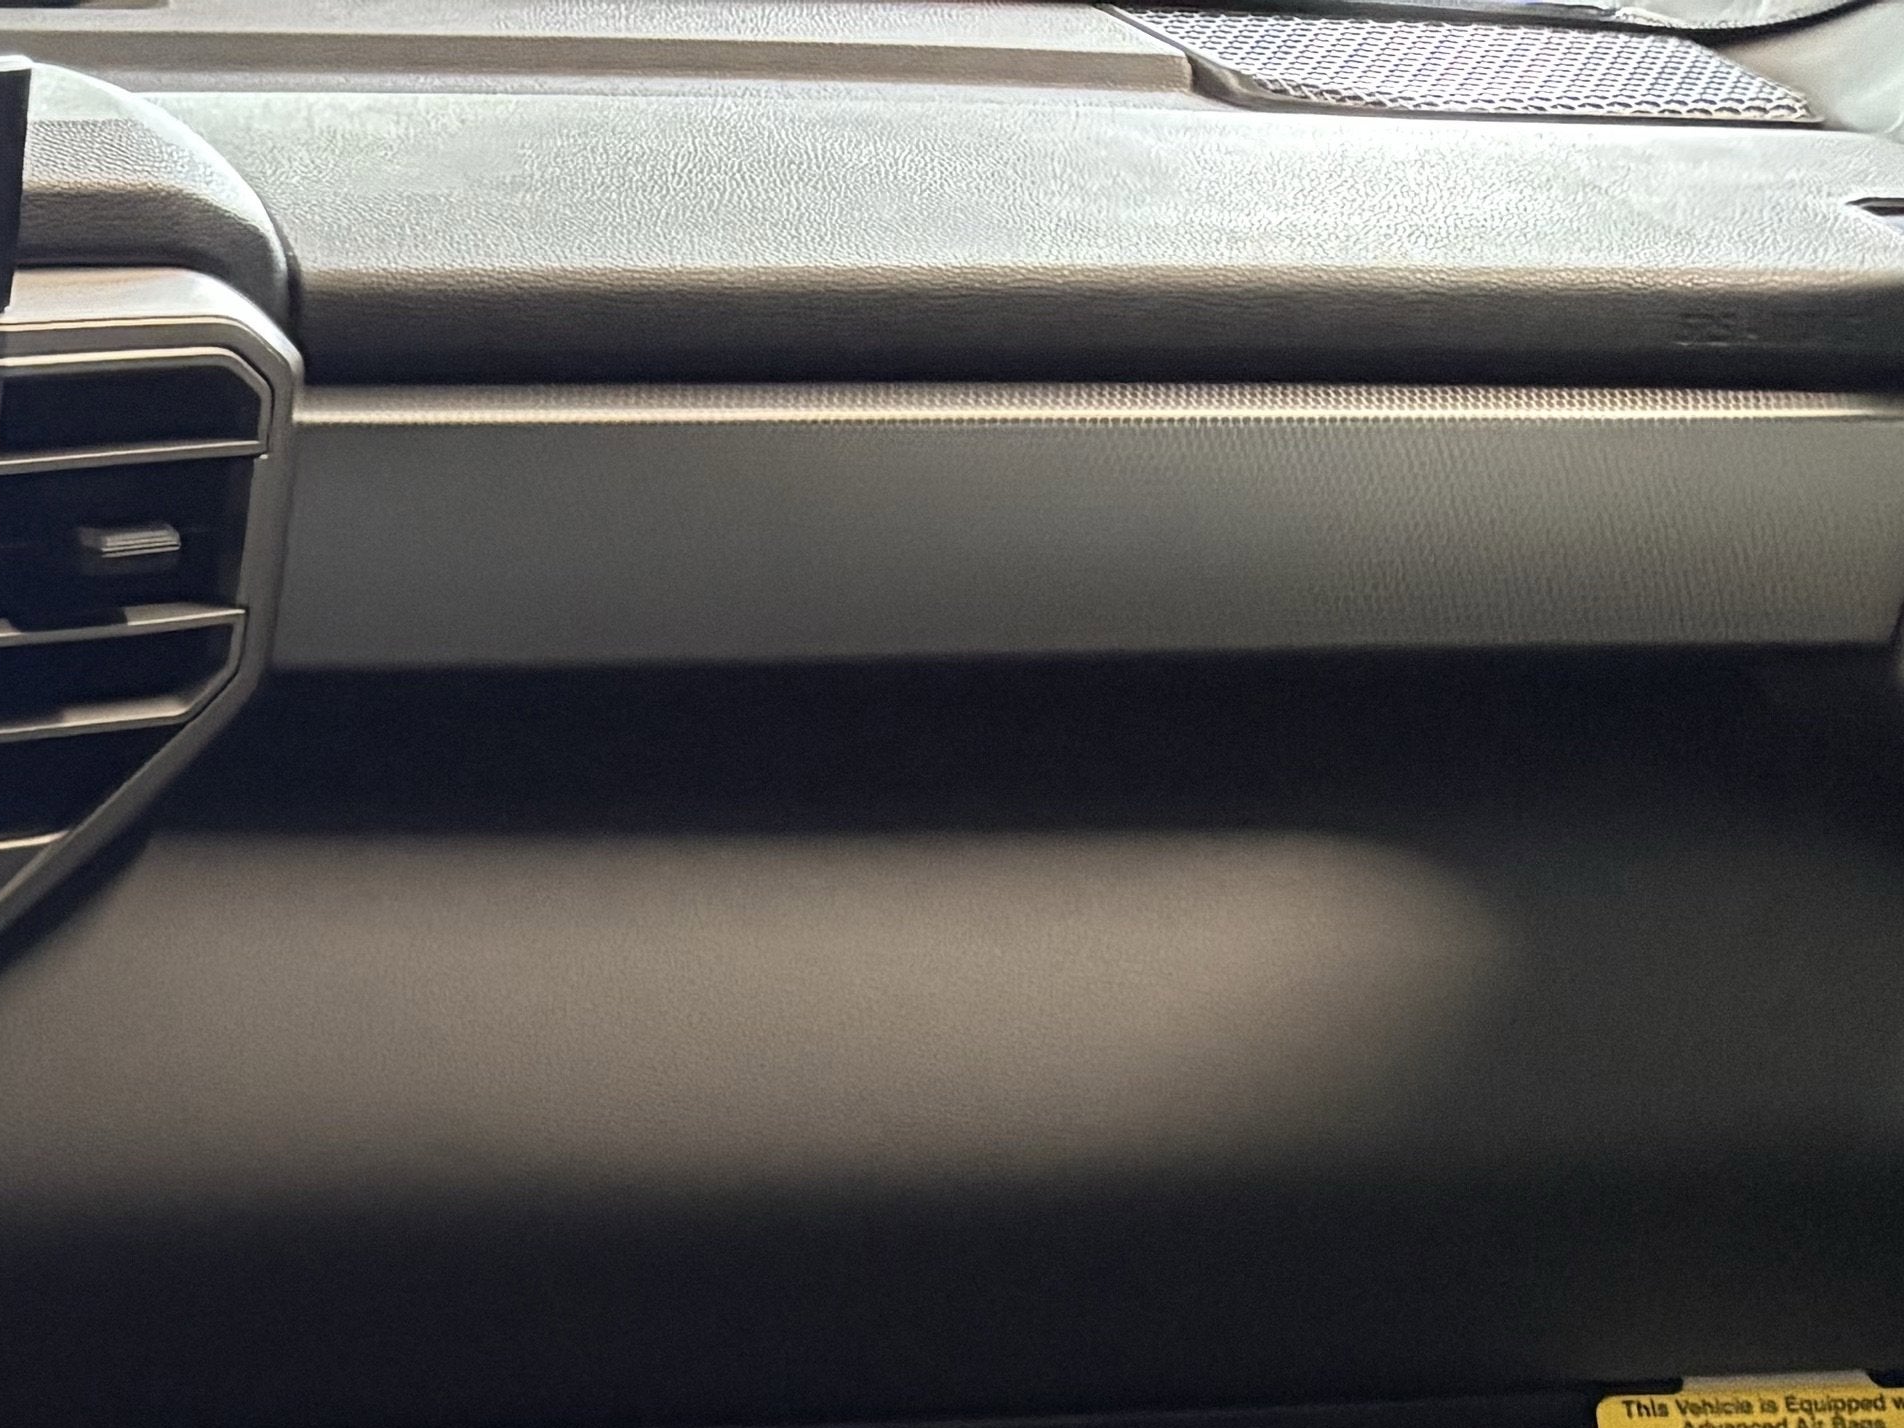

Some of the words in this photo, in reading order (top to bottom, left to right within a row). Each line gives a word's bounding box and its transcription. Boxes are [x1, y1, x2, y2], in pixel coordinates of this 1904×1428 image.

[1622, 1398, 1669, 1418] This
[1675, 1397, 1753, 1416] Vehicle
[1758, 1396, 1778, 1413] is
[1785, 1393, 1887, 1420] Equipped
